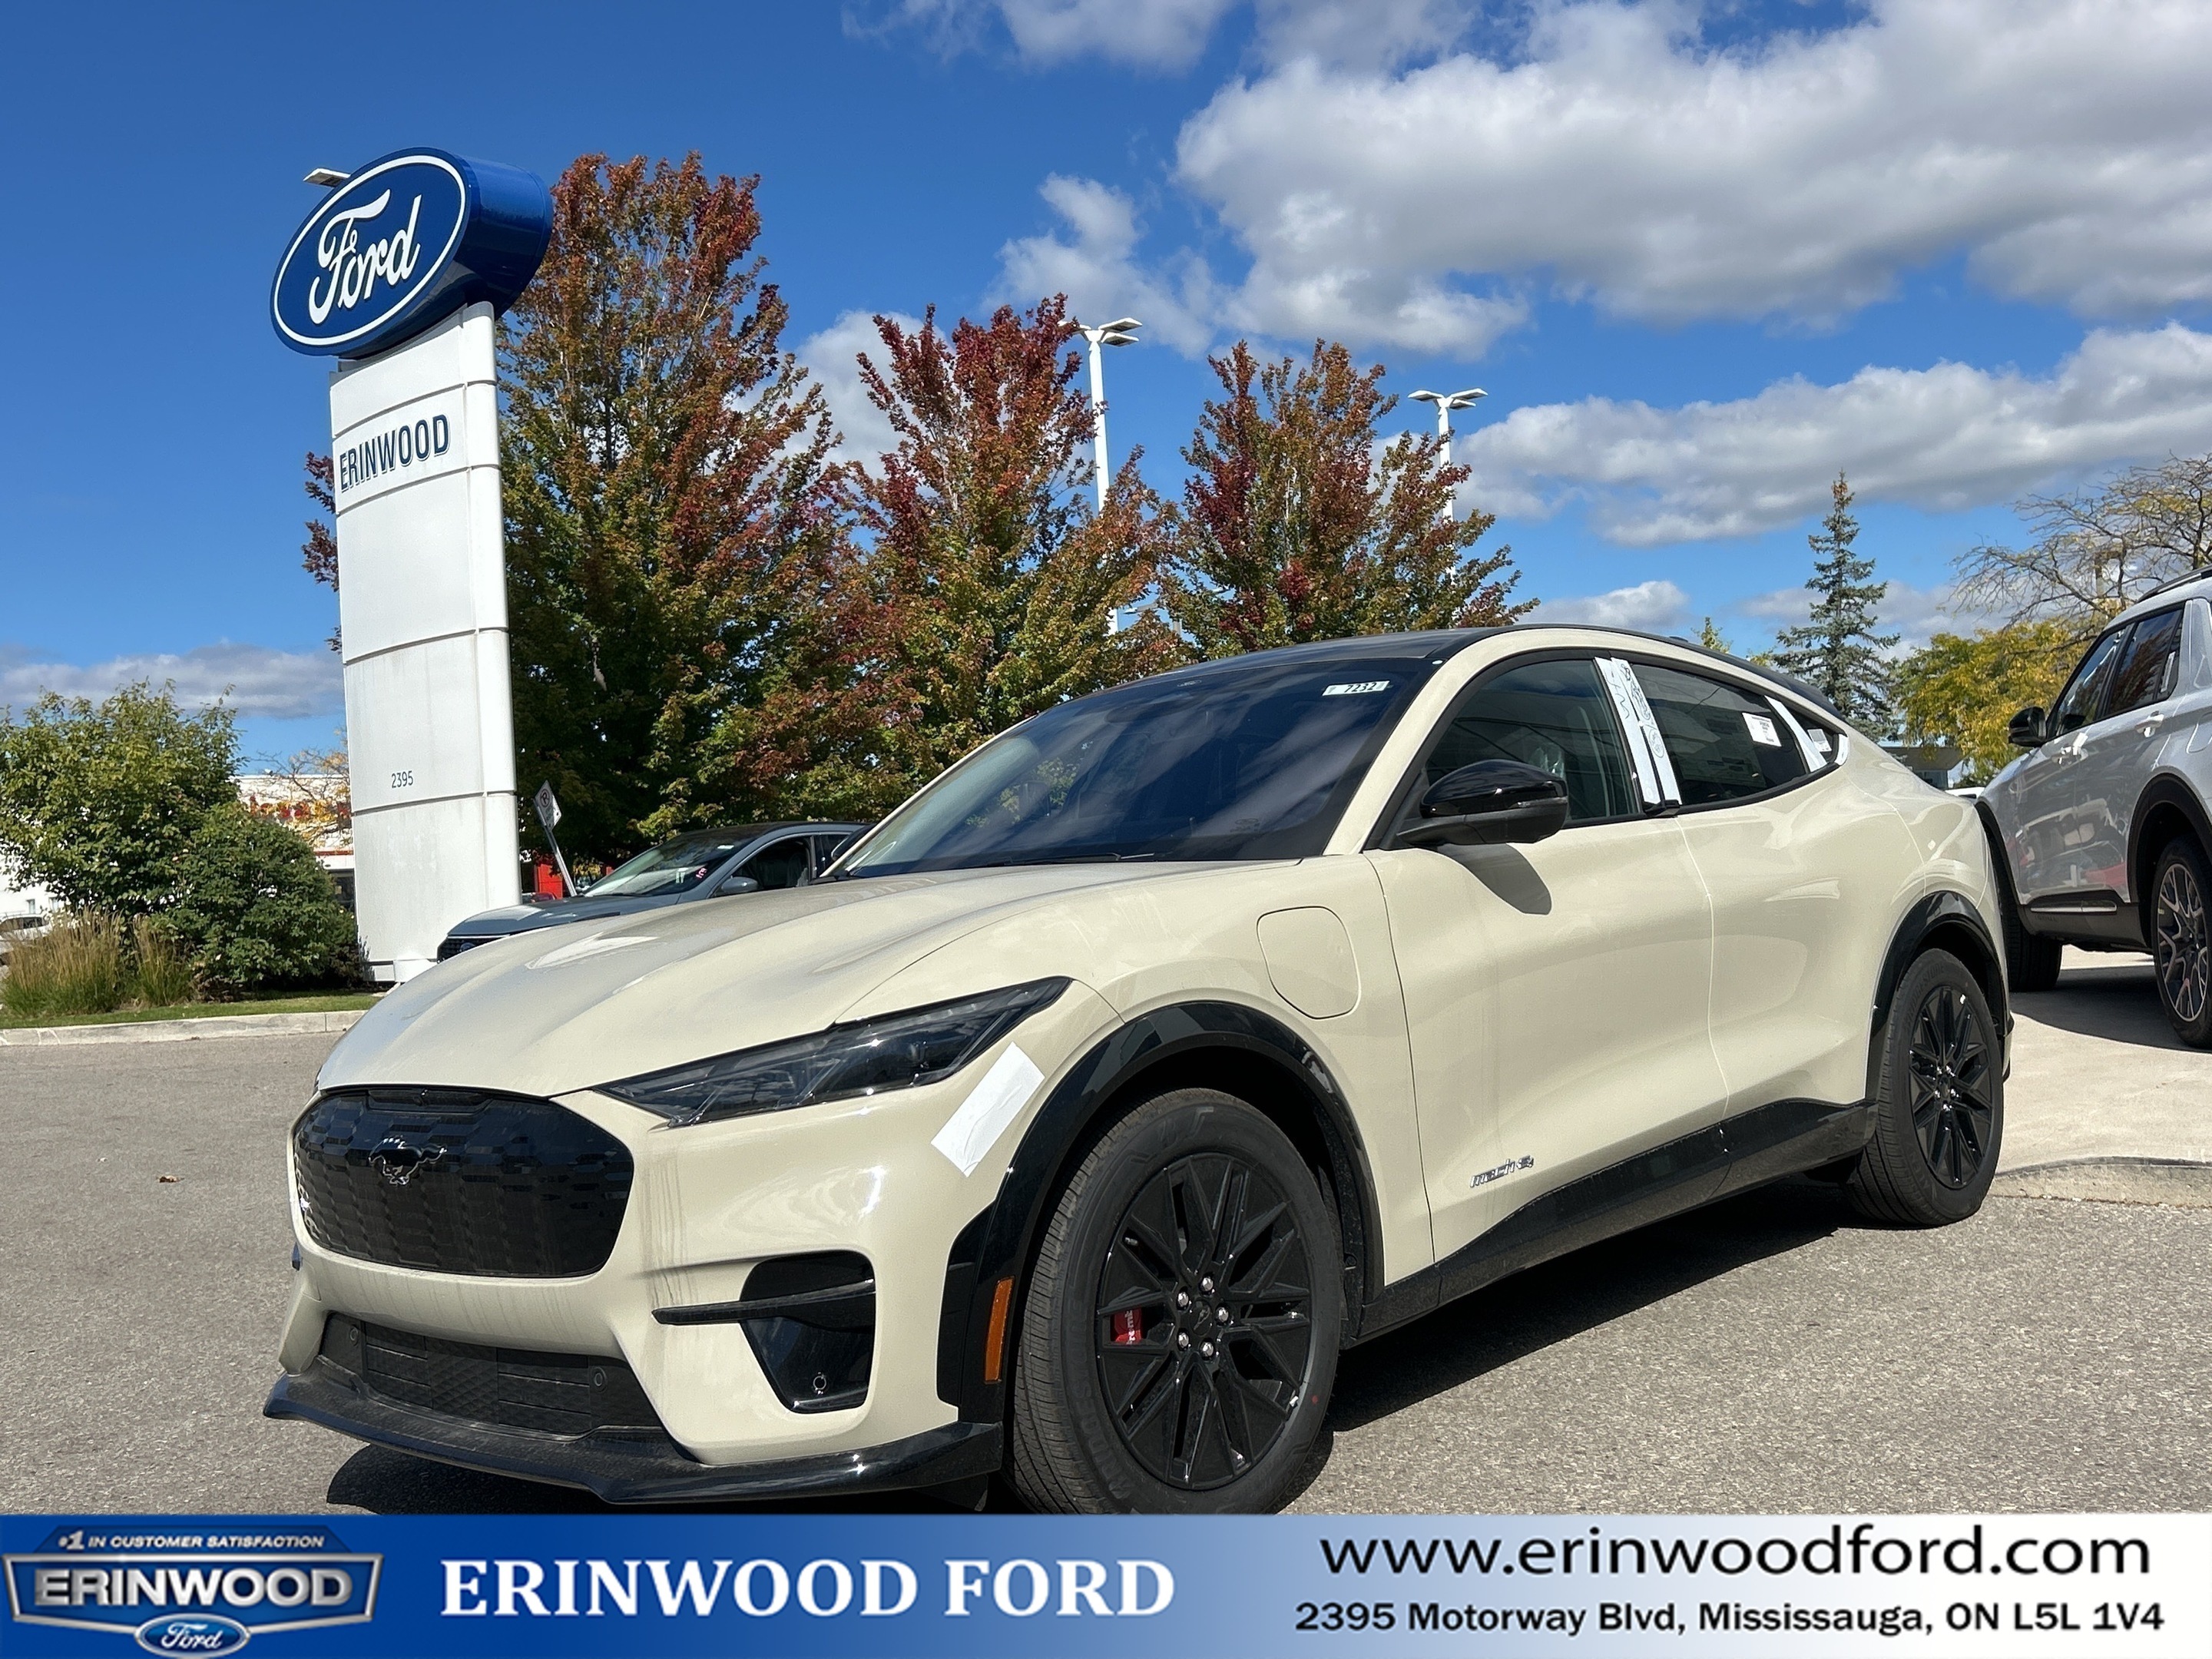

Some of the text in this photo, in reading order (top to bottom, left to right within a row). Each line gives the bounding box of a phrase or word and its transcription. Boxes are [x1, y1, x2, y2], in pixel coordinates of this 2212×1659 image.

[309, 189, 422, 324] Ford
[339, 414, 449, 492] ERINWOOD
[1345, 683, 1376, 693] 7232
[391, 770, 414, 788] 2395
